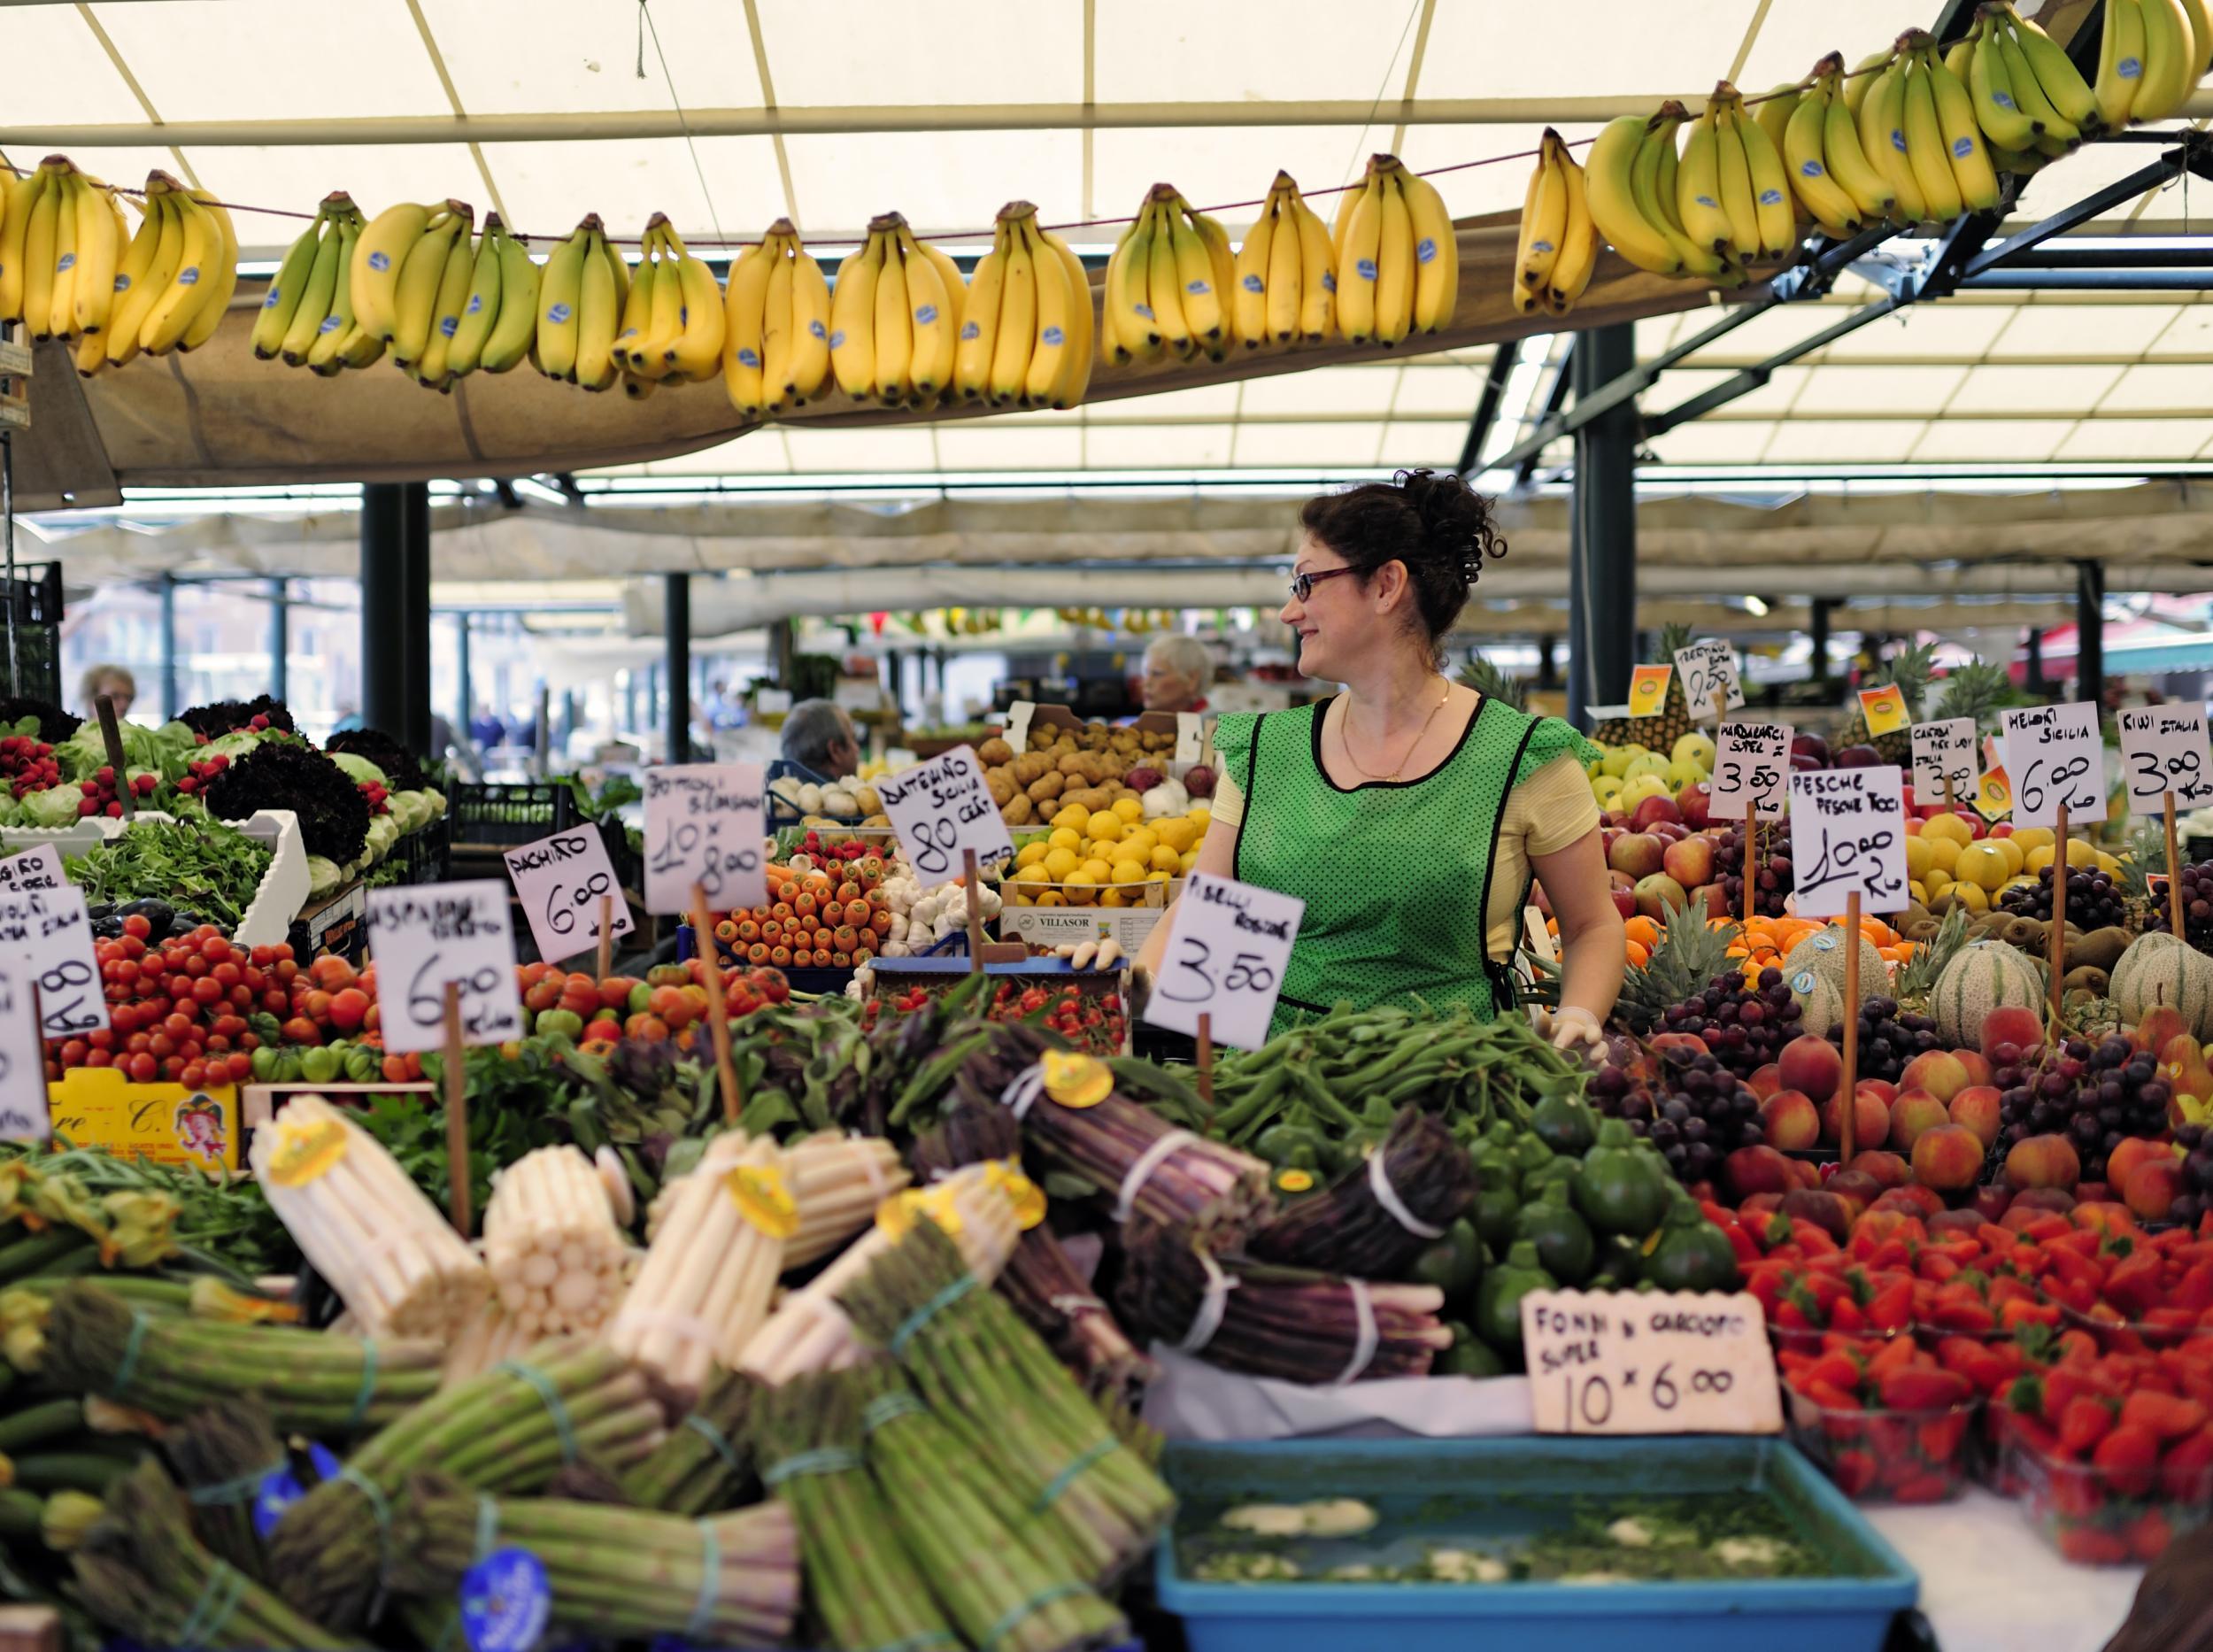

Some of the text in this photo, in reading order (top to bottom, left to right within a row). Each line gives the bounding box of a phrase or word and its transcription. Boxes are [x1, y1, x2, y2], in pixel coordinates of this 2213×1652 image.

[2009, 707, 2056, 730] MELONI
[2123, 714, 2200, 735] KIWI ITALIA
[2039, 725, 2089, 744] SICILIA
[1792, 774, 1863, 796] PESCHE
[1816, 797, 1862, 815] PESCHE
[912, 818, 957, 874] 80
[1040, 918, 1090, 927] VILLASOR
[1564, 1373, 1614, 1432] 10
